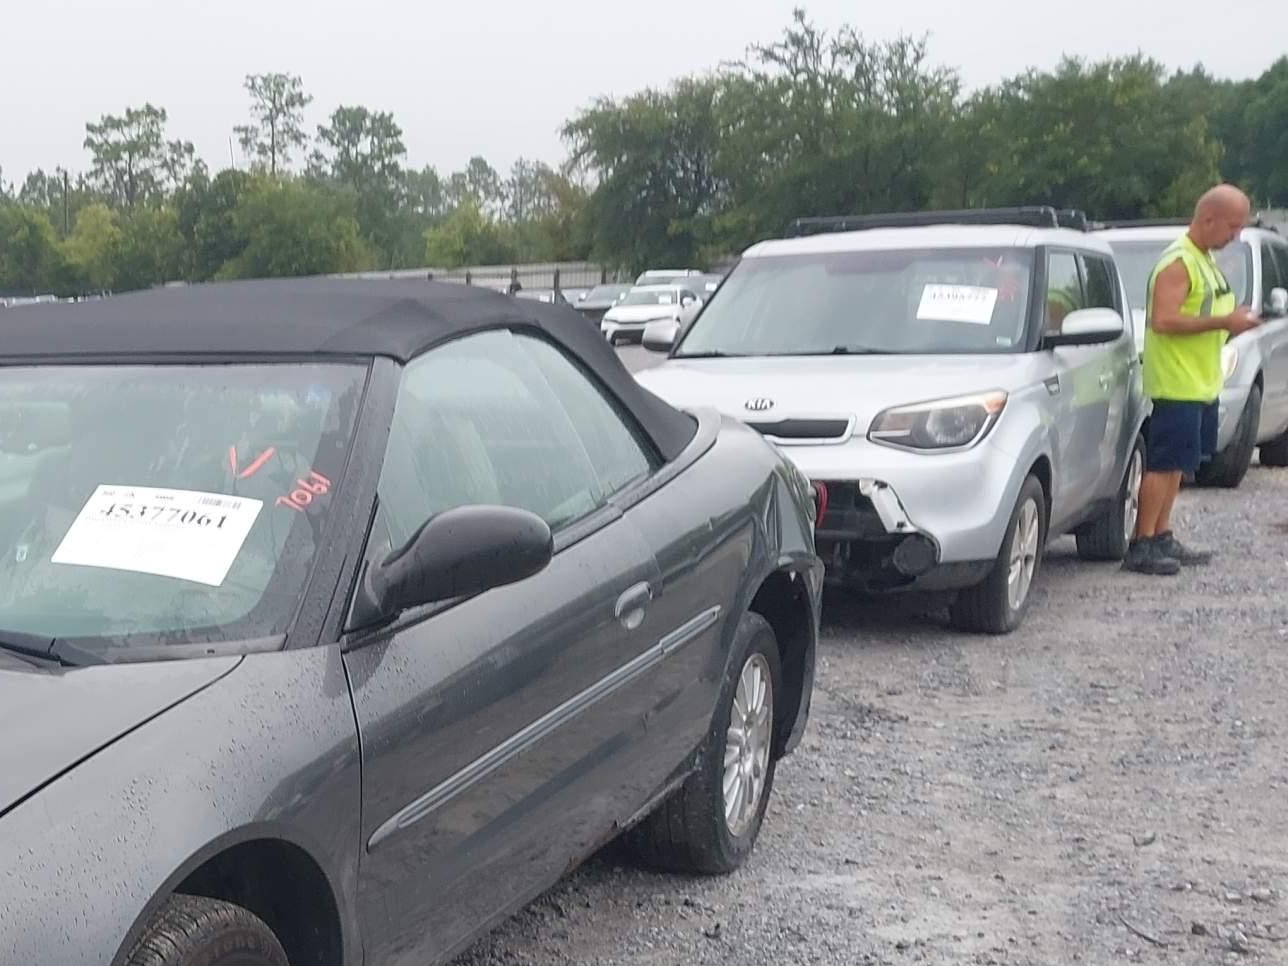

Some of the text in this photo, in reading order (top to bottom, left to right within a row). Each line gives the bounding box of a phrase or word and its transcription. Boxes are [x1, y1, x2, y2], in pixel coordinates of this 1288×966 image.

[746, 398, 773, 411] KIA
[274, 467, 332, 513] 7061
[99, 502, 228, 529] 45377061
